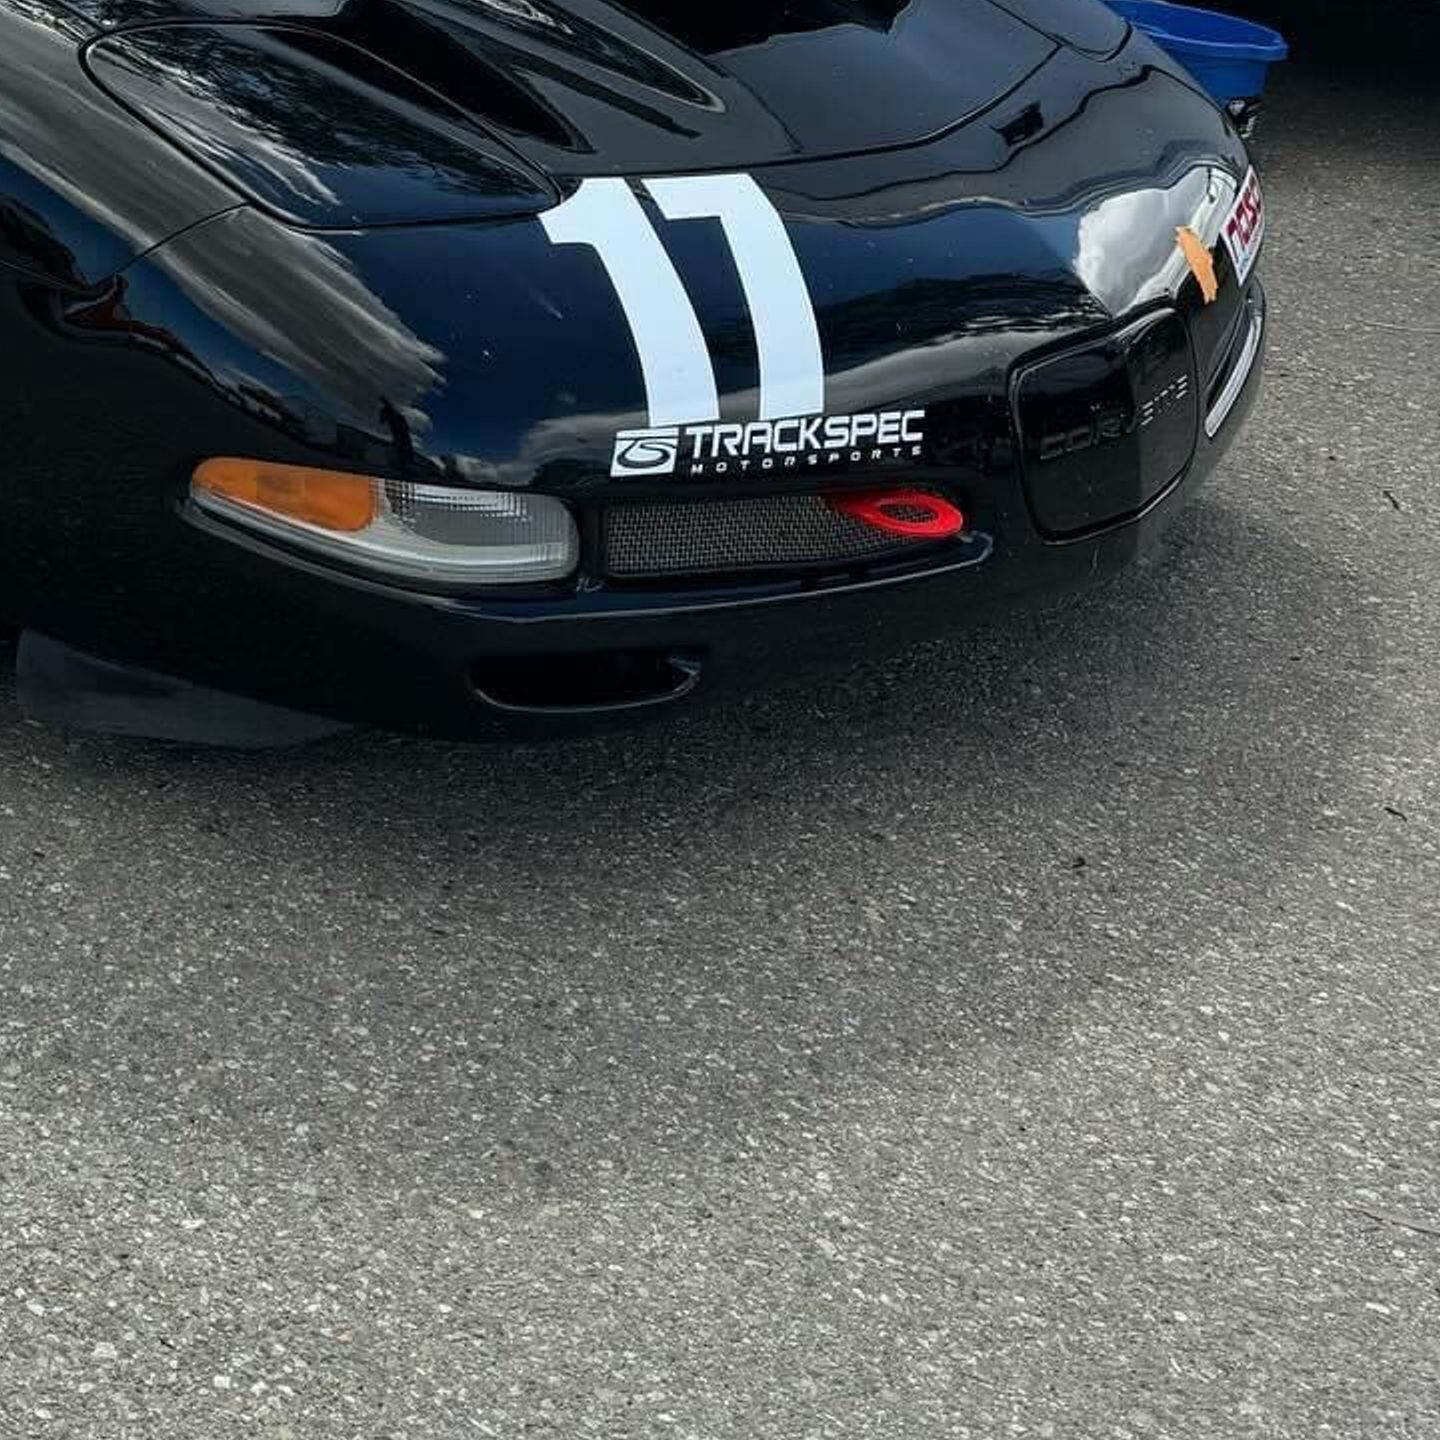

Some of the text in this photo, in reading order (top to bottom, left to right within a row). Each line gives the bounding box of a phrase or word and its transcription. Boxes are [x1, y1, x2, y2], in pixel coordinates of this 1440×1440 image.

[536, 172, 825, 428] 17
[685, 410, 926, 459] TRACKSPEC
[690, 445, 923, 475] MOTORSPORTS
